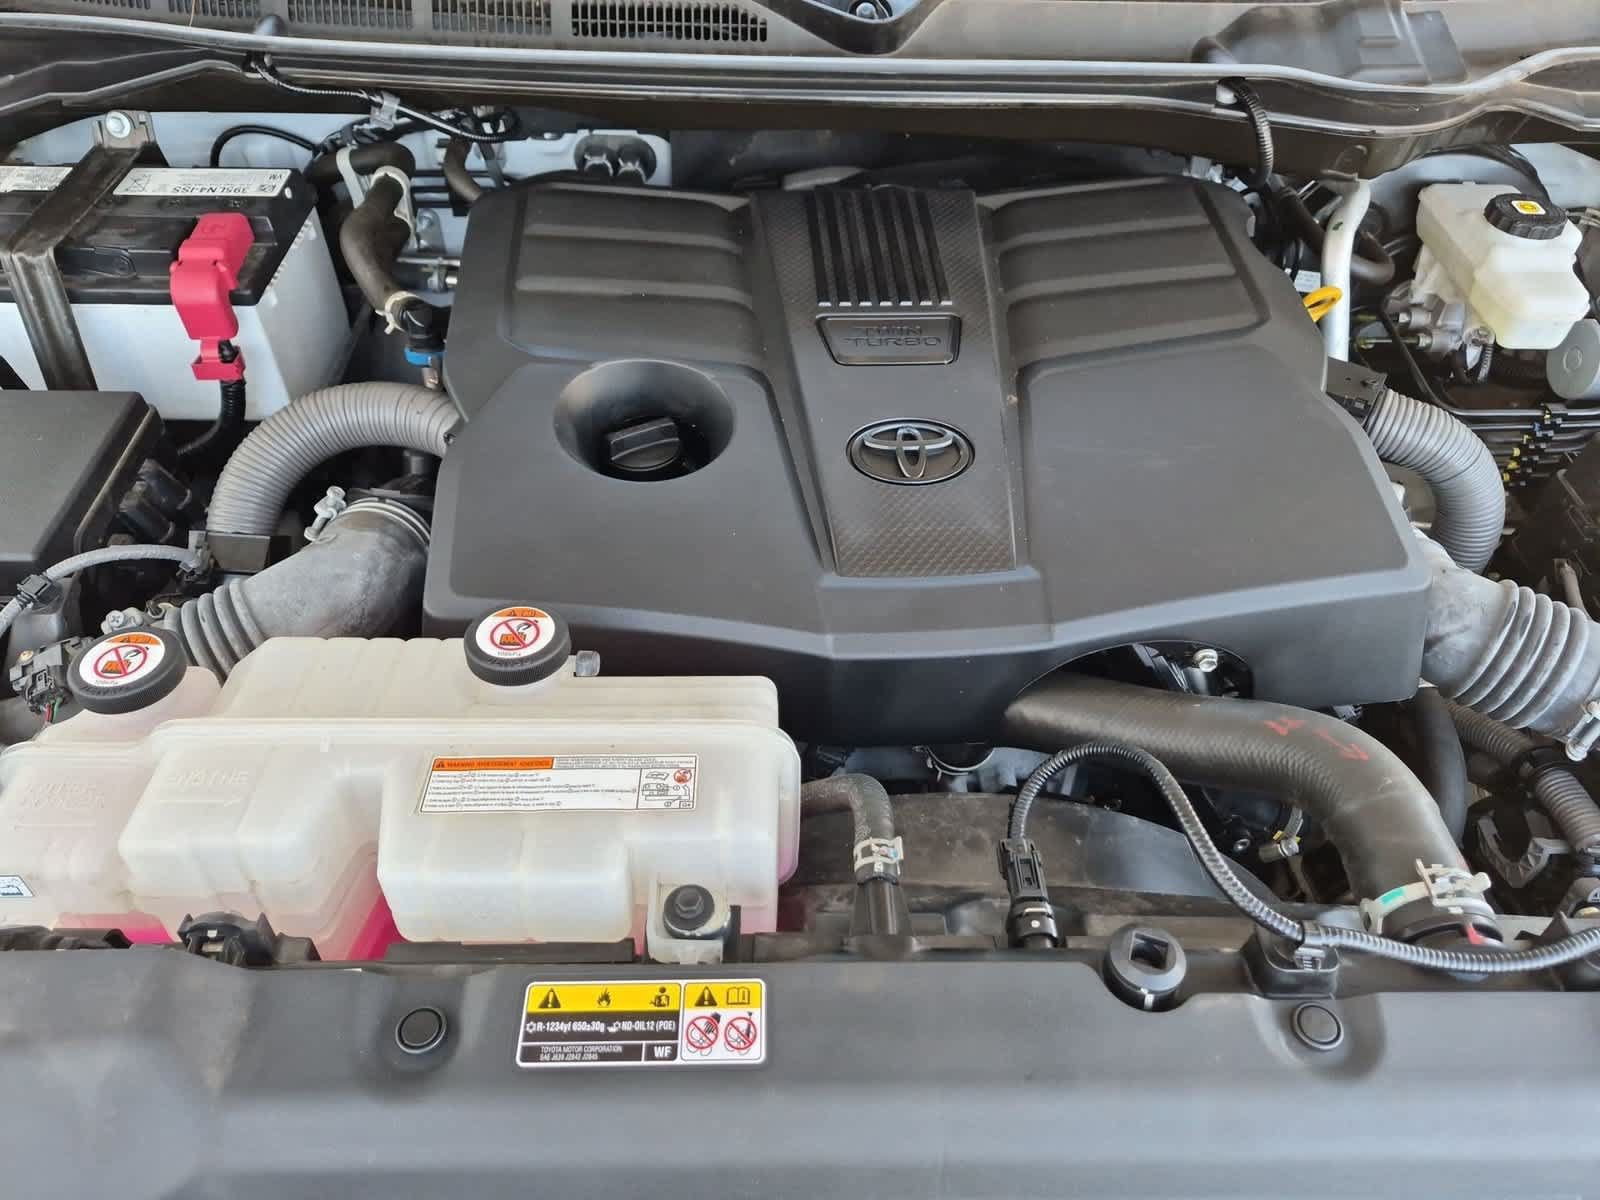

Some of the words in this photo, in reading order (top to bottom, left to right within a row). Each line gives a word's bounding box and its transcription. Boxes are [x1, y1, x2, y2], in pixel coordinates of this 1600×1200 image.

[844, 336, 942, 347] TURBO
[536, 1021, 572, 1033] R-1234yf
[583, 1045, 622, 1053] CORPORATION
[653, 1046, 672, 1058] WF
